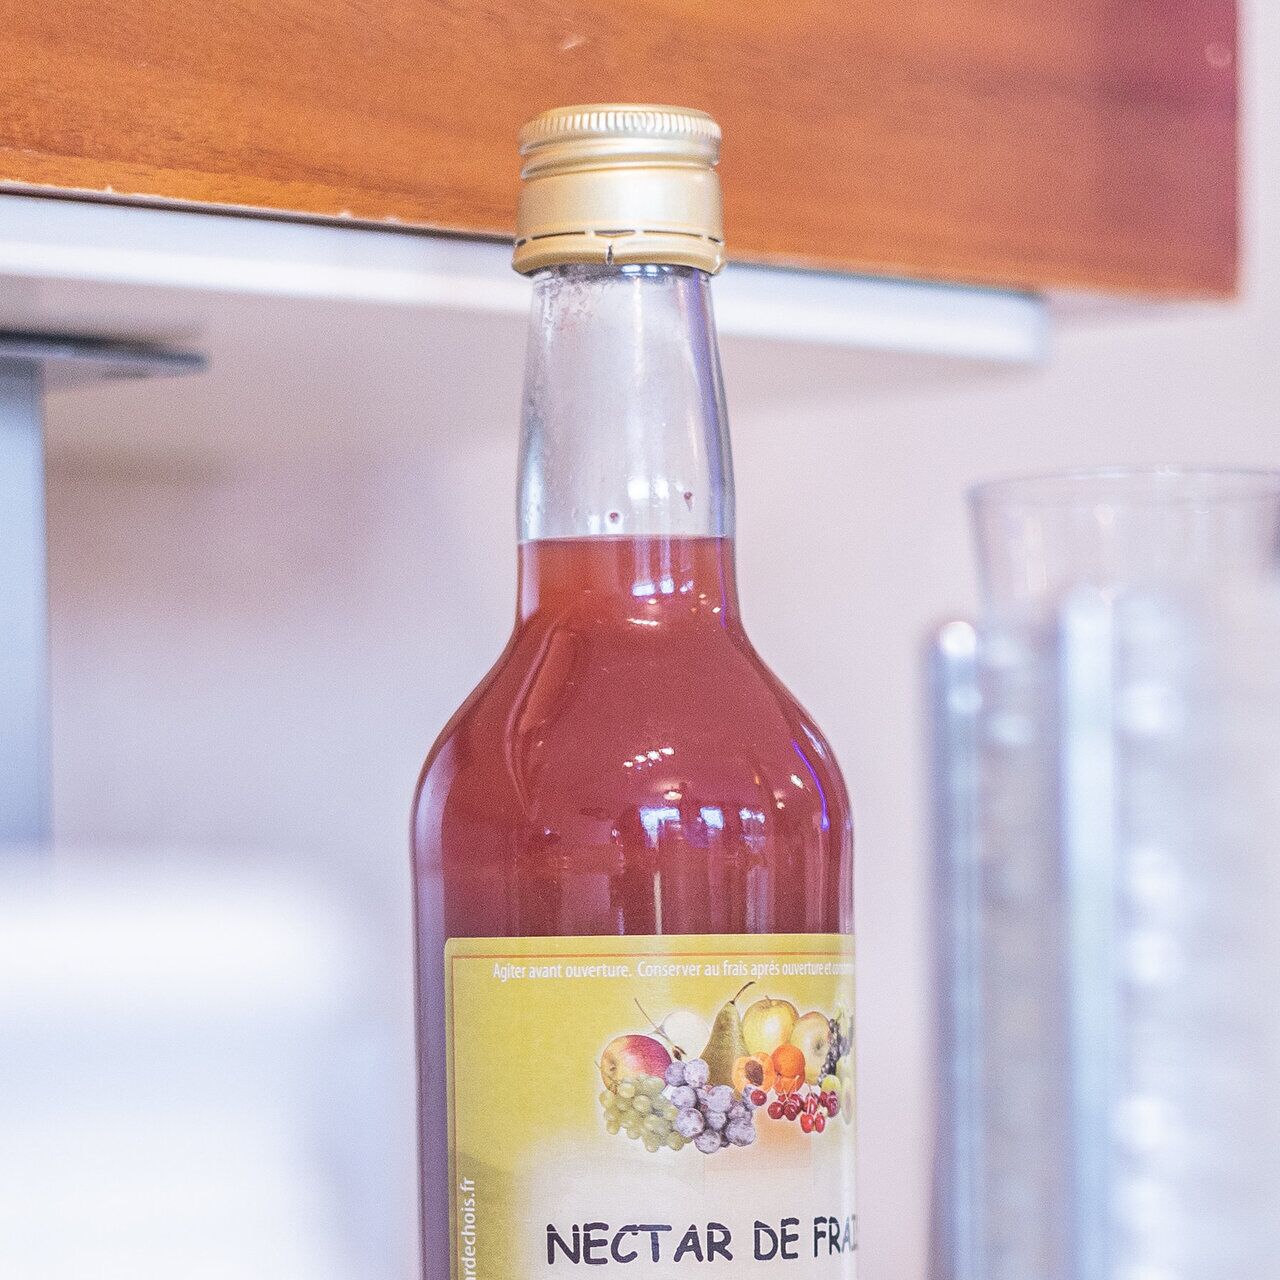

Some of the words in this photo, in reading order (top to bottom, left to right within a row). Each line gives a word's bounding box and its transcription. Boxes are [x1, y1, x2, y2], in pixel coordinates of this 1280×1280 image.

[493, 962, 526, 982] Agiter
[528, 964, 562, 978] avant
[565, 963, 632, 977] ouverture.
[637, 960, 700, 977] Conserver
[704, 963, 720, 976] au
[723, 960, 748, 976] frais
[782, 962, 824, 976] ouverture
[547, 1222, 733, 1265] NECTAR
[753, 1217, 800, 1261] DE
